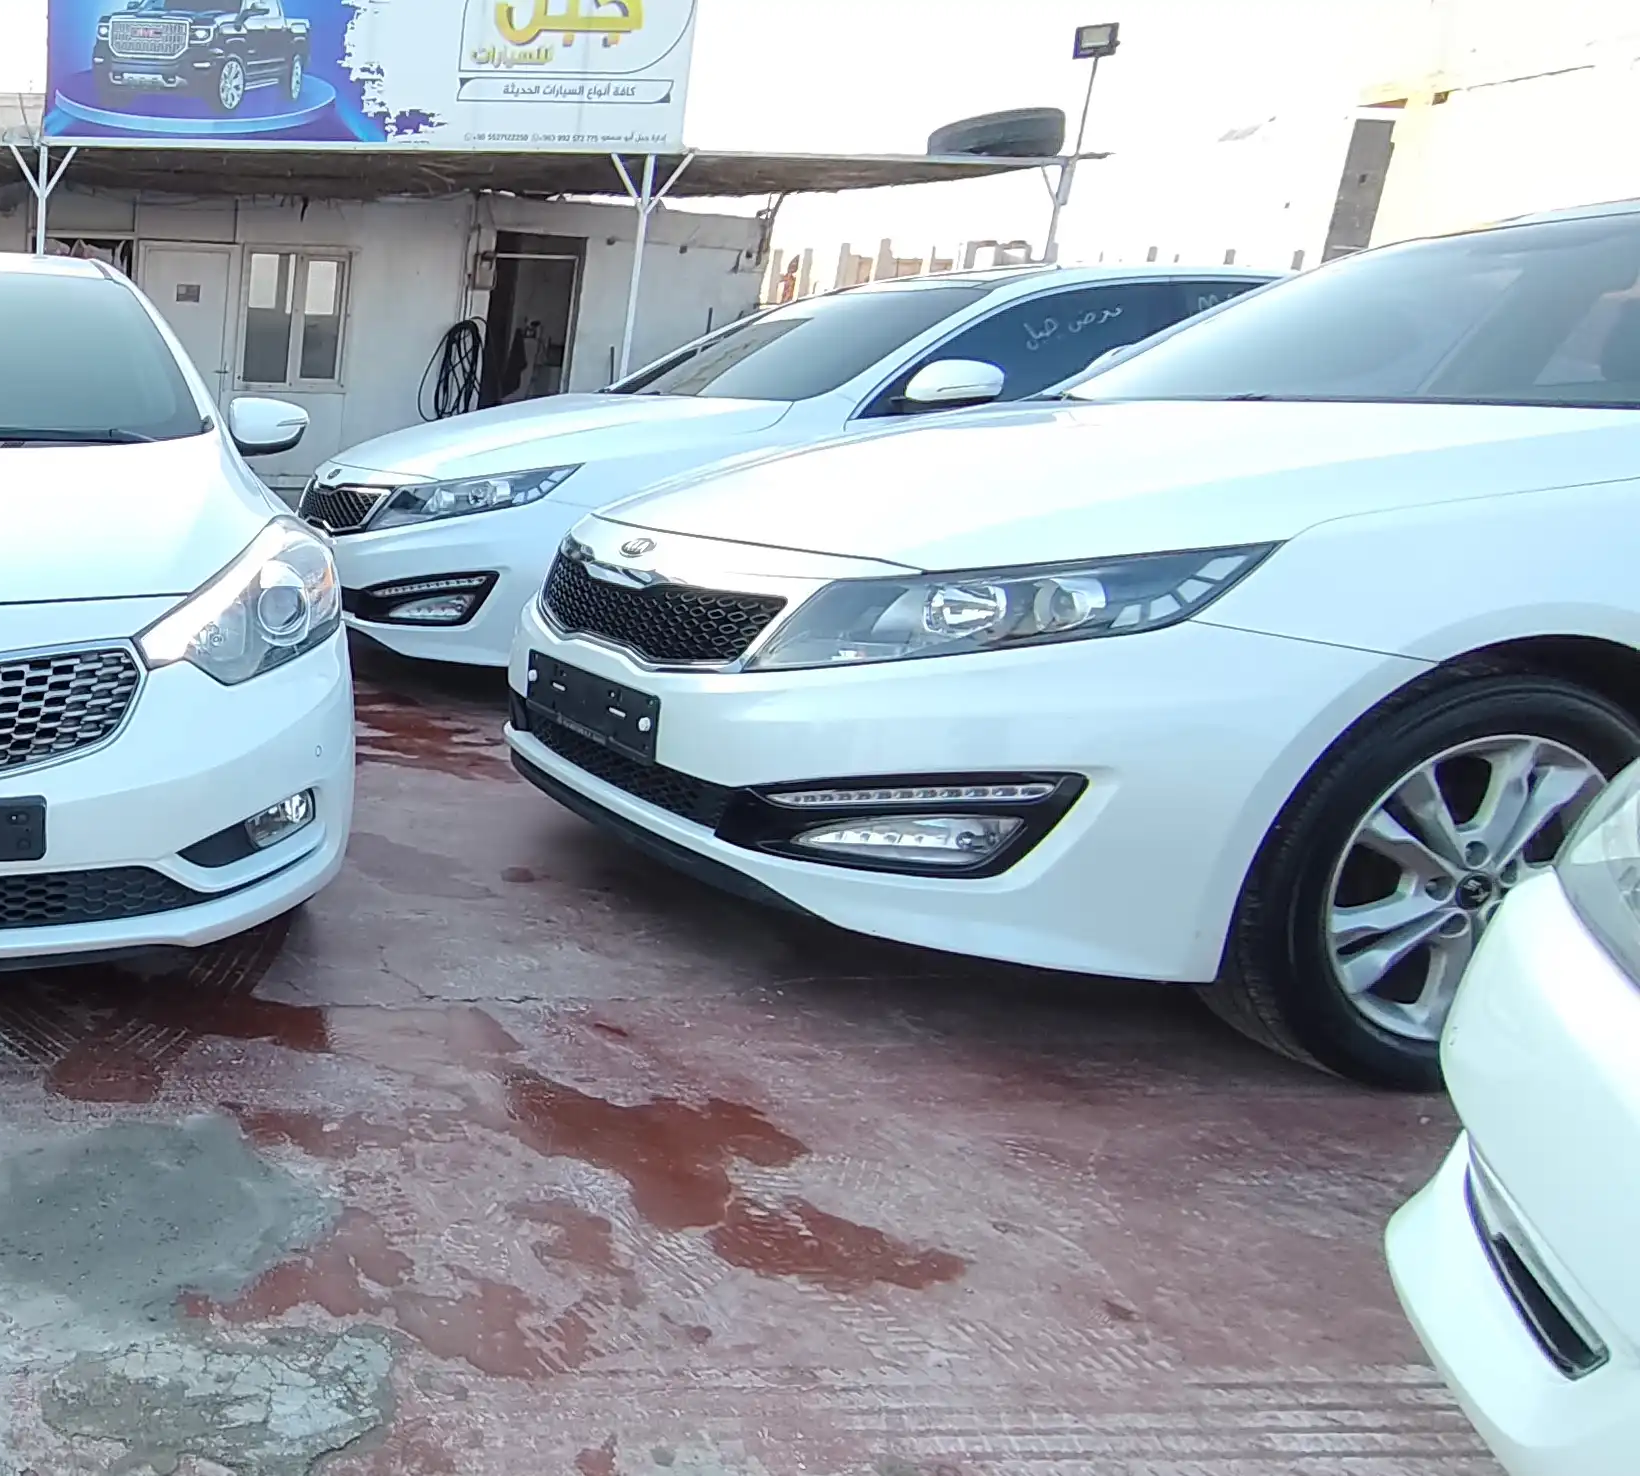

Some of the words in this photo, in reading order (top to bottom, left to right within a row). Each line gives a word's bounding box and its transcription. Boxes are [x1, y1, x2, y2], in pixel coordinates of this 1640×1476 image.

[470, 44, 554, 68] للسيارات
[503, 83, 540, 95] الحديثة
[542, 84, 585, 98] السيارات
[587, 84, 611, 99] أنواع
[613, 86, 636, 97] كافة
